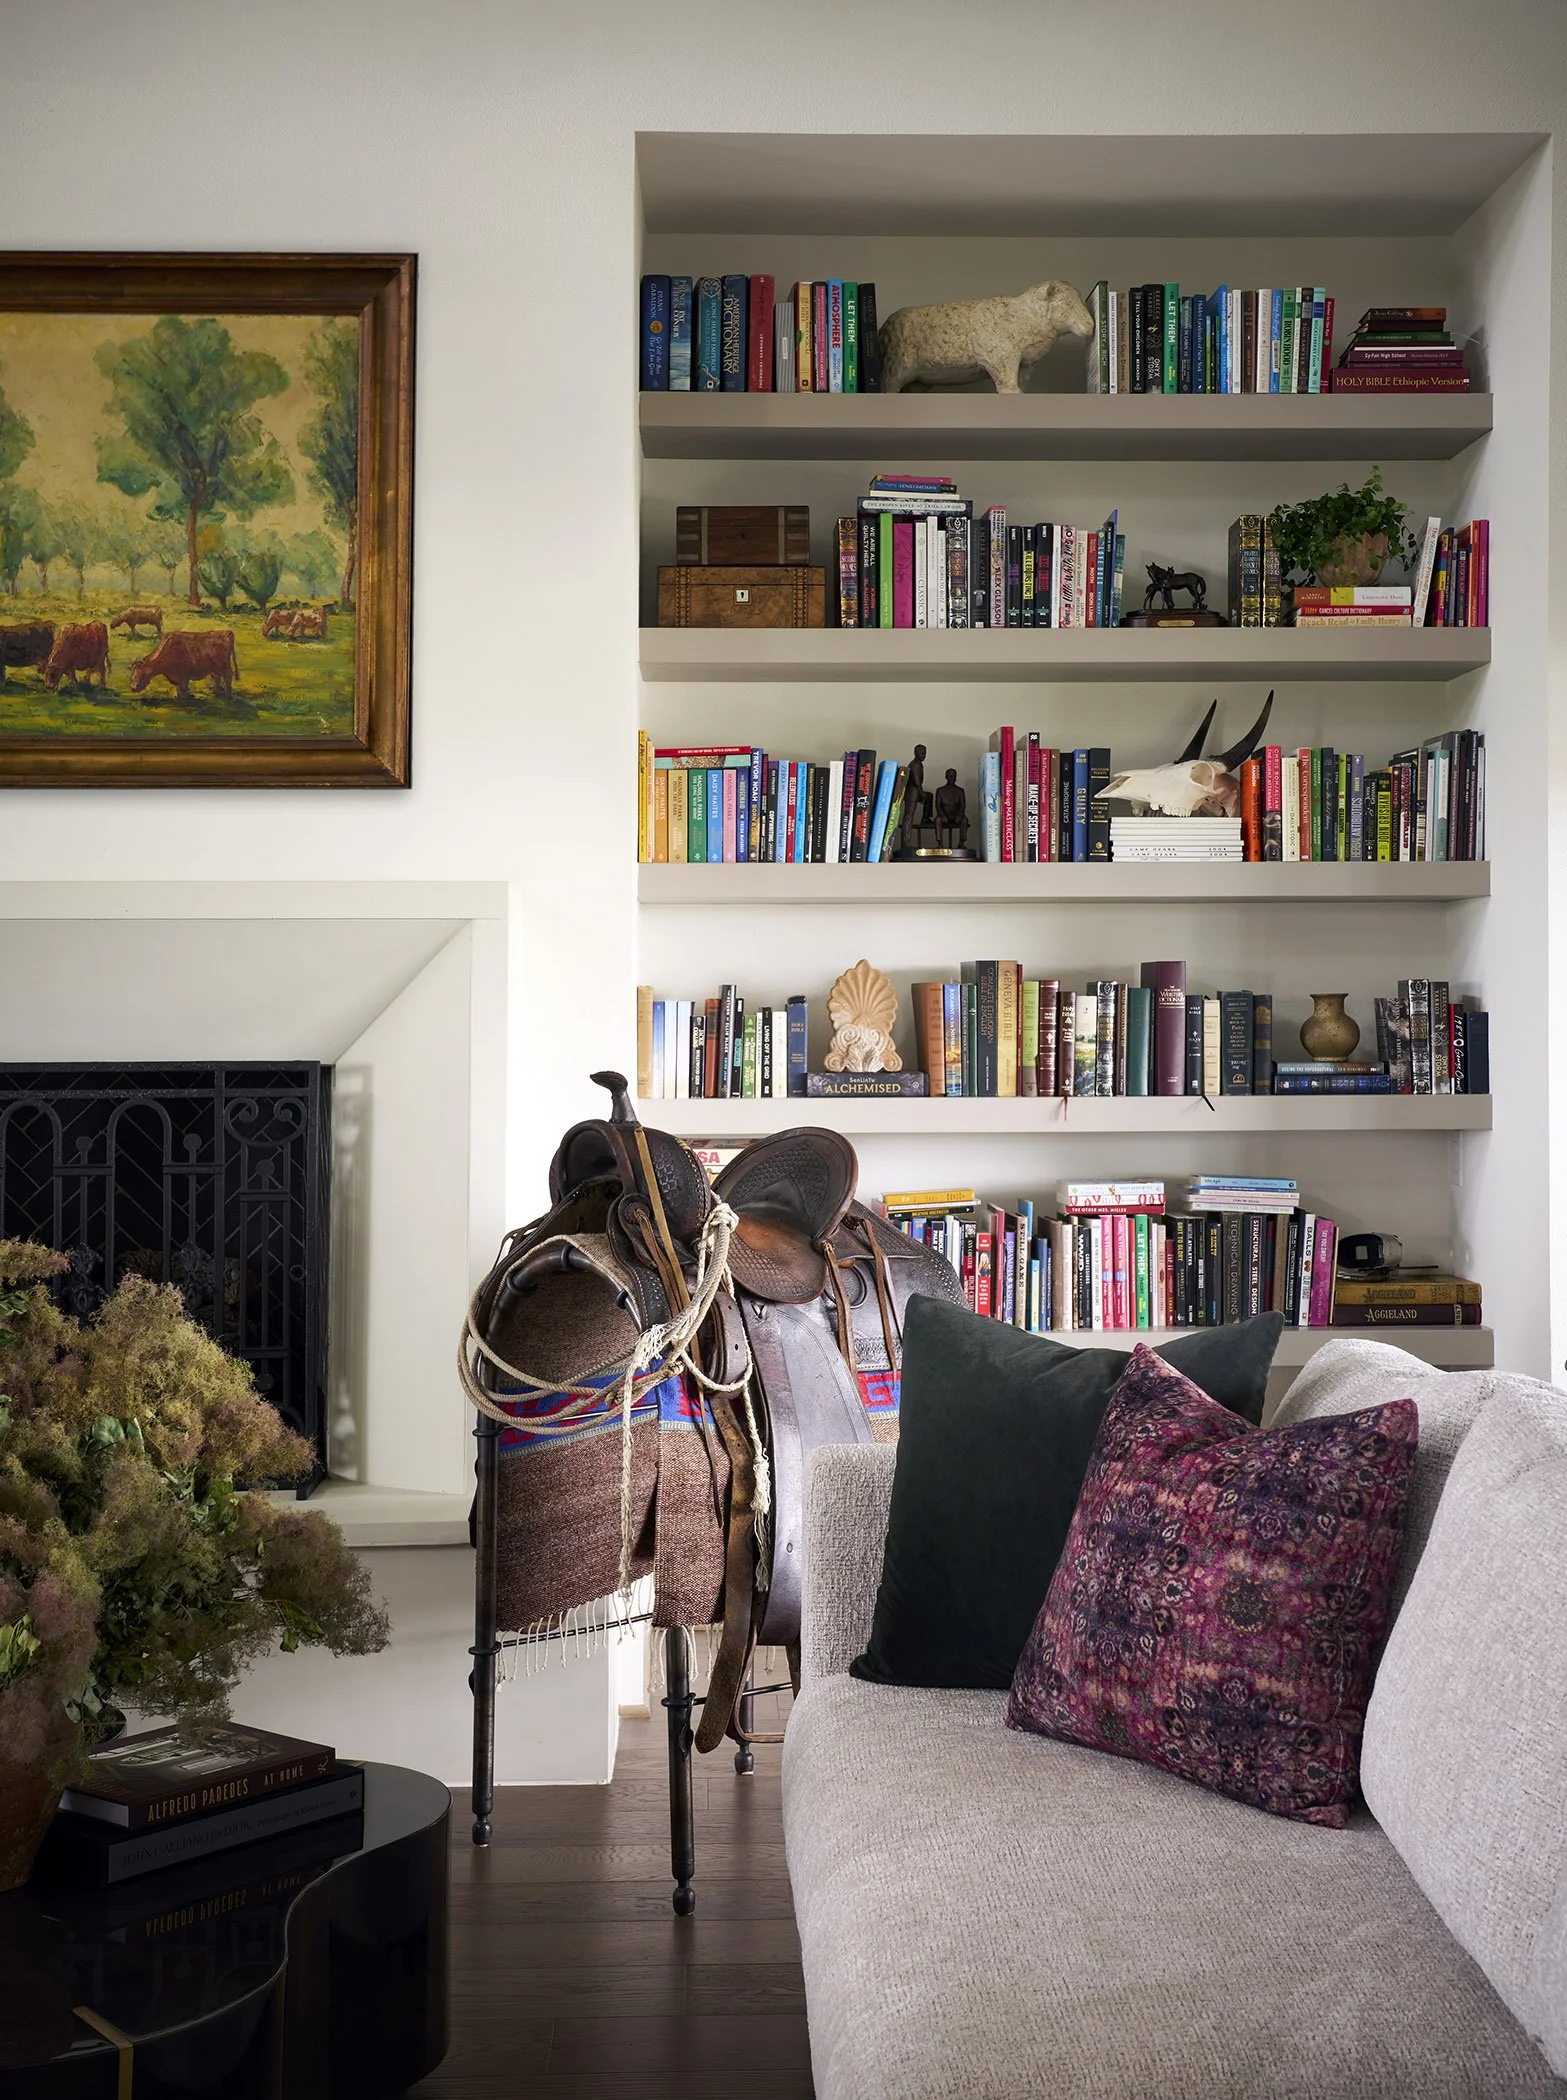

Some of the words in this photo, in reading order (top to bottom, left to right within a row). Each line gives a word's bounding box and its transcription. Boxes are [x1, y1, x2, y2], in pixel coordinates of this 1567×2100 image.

[832, 285, 840, 348] ATMOSPHERE
[723, 298, 733, 373] DICTIONARY
[1283, 321, 1292, 342] ROBIN
[1283, 343, 1291, 365] HOOD
[1336, 378, 1365, 386] HOLY
[1393, 378, 1430, 388] Ethiopic
[1431, 377, 1463, 385] Version
[870, 527, 875, 537] WE
[1024, 551, 1033, 570] KILLER
[1024, 572, 1033, 599] INSTINCT
[1028, 784, 1038, 814] MAKE-UP
[1077, 788, 1086, 824] GUILTY
[1379, 794, 1389, 824] GRISHAM
[1028, 816, 1038, 844] SECRETS
[1379, 826, 1389, 843] JOHN
[1004, 971, 1012, 1009] GENEVA
[1004, 1012, 1012, 1041] BIBLE
[1455, 1015, 1464, 1038] 1984
[1455, 1049, 1463, 1069] George
[826, 1084, 901, 1093] ALCHEMISED
[1455, 1070, 1464, 1092] Orwell
[1365, 1308, 1417, 1322] AGGIELAND
[264, 1774, 274, 1786] AT
[279, 1764, 304, 1783] HOME
[148, 1792, 197, 1822] ALFREDO
[202, 1778, 249, 1807] PAREDES
[121, 1848, 152, 1866] JOHN
[154, 1832, 210, 1860] GALLIANO
[209, 1830, 222, 1843] for
[224, 1821, 252, 1839] DIOR
